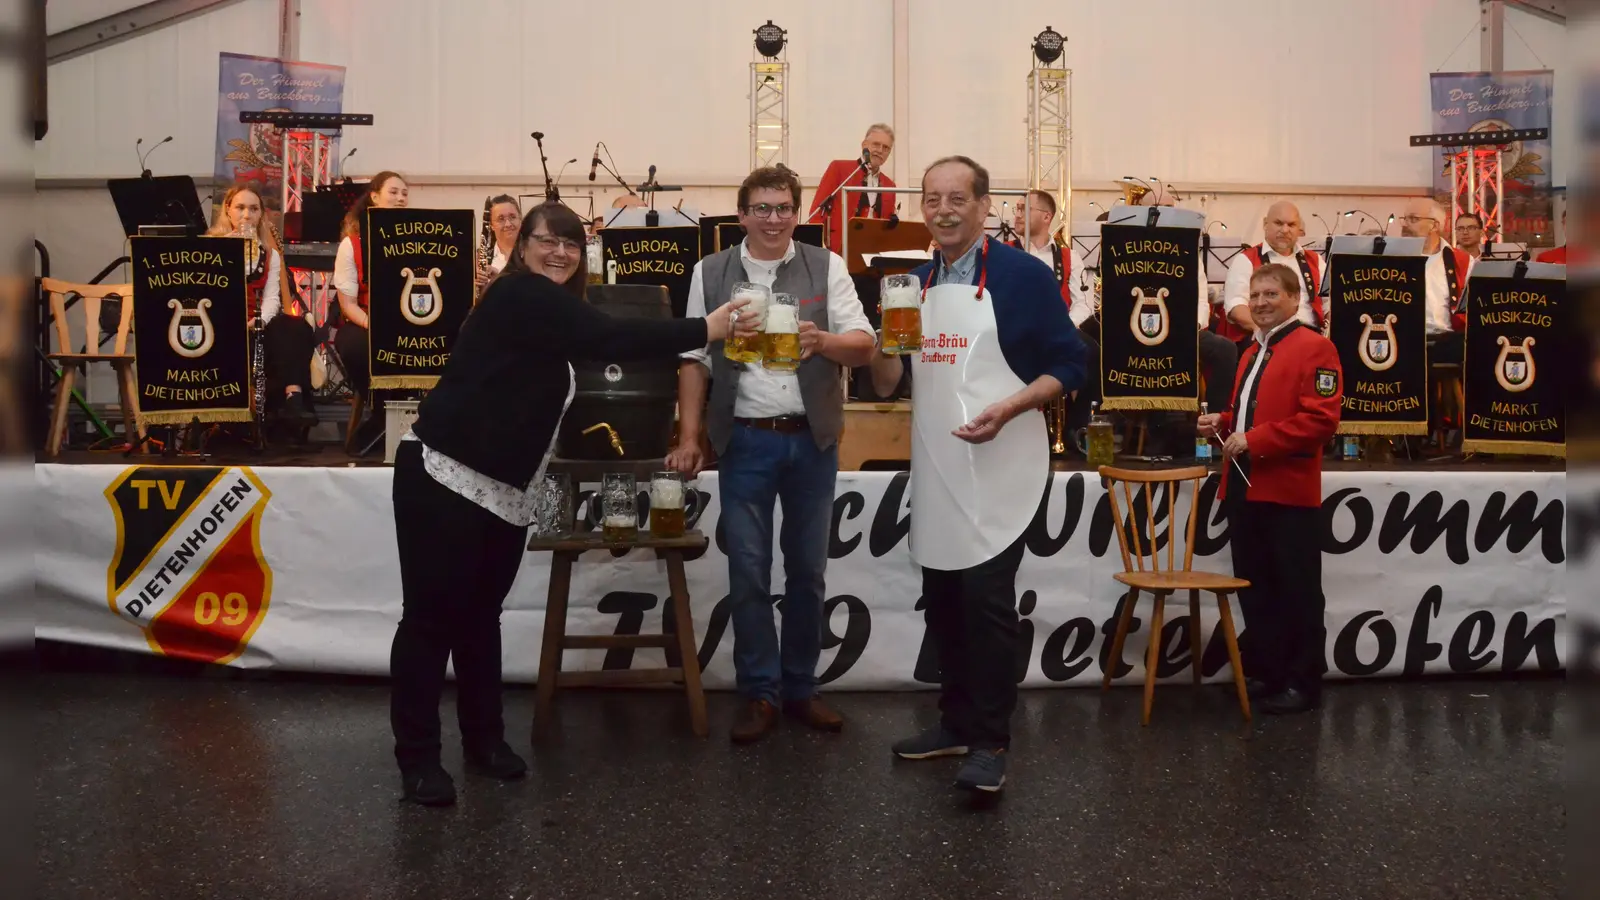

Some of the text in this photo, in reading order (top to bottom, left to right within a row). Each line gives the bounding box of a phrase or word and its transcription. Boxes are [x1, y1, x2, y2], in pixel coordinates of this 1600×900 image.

[238, 72, 325, 88] Der Himmel
[227, 91, 249, 100] aus
[1448, 82, 1533, 102] Der Himmel
[1440, 106, 1460, 116] aus
[379, 227, 391, 239] 1.
[395, 221, 453, 237] EUROPA
[383, 241, 458, 258] MUSIKZUG
[607, 247, 618, 259] 1.
[622, 239, 679, 256] EUROPA
[1110, 245, 1121, 257] 1.
[1125, 240, 1180, 256] EUROPA
[142, 257, 155, 269] 1.
[159, 251, 223, 266] EUROPA
[1114, 261, 1185, 278] MUSIKZUG
[1339, 273, 1350, 285] 1.
[1354, 268, 1408, 283] EUROPA
[148, 272, 229, 289] MUSIKZUG
[1343, 288, 1413, 305] MUSIKZUG
[1477, 296, 1488, 308] 1.
[1492, 291, 1548, 307] EUROPA
[1480, 311, 1552, 328] MUSIKZUG
[397, 335, 447, 349] MARKT
[376, 349, 450, 367] DIETENHOF
[1127, 355, 1173, 370] MARKT
[166, 367, 220, 382] MARKT
[1108, 369, 1191, 388] DIETENHOFEN
[144, 381, 241, 401] DIETENHOFEN
[1356, 381, 1402, 395] MARKT
[1491, 401, 1539, 416] MARKT
[1470, 413, 1558, 432] DIETENHOFEN
[130, 479, 185, 510] TV
[125, 478, 252, 618] DIETENHOFEN
[194, 592, 248, 626] 09
